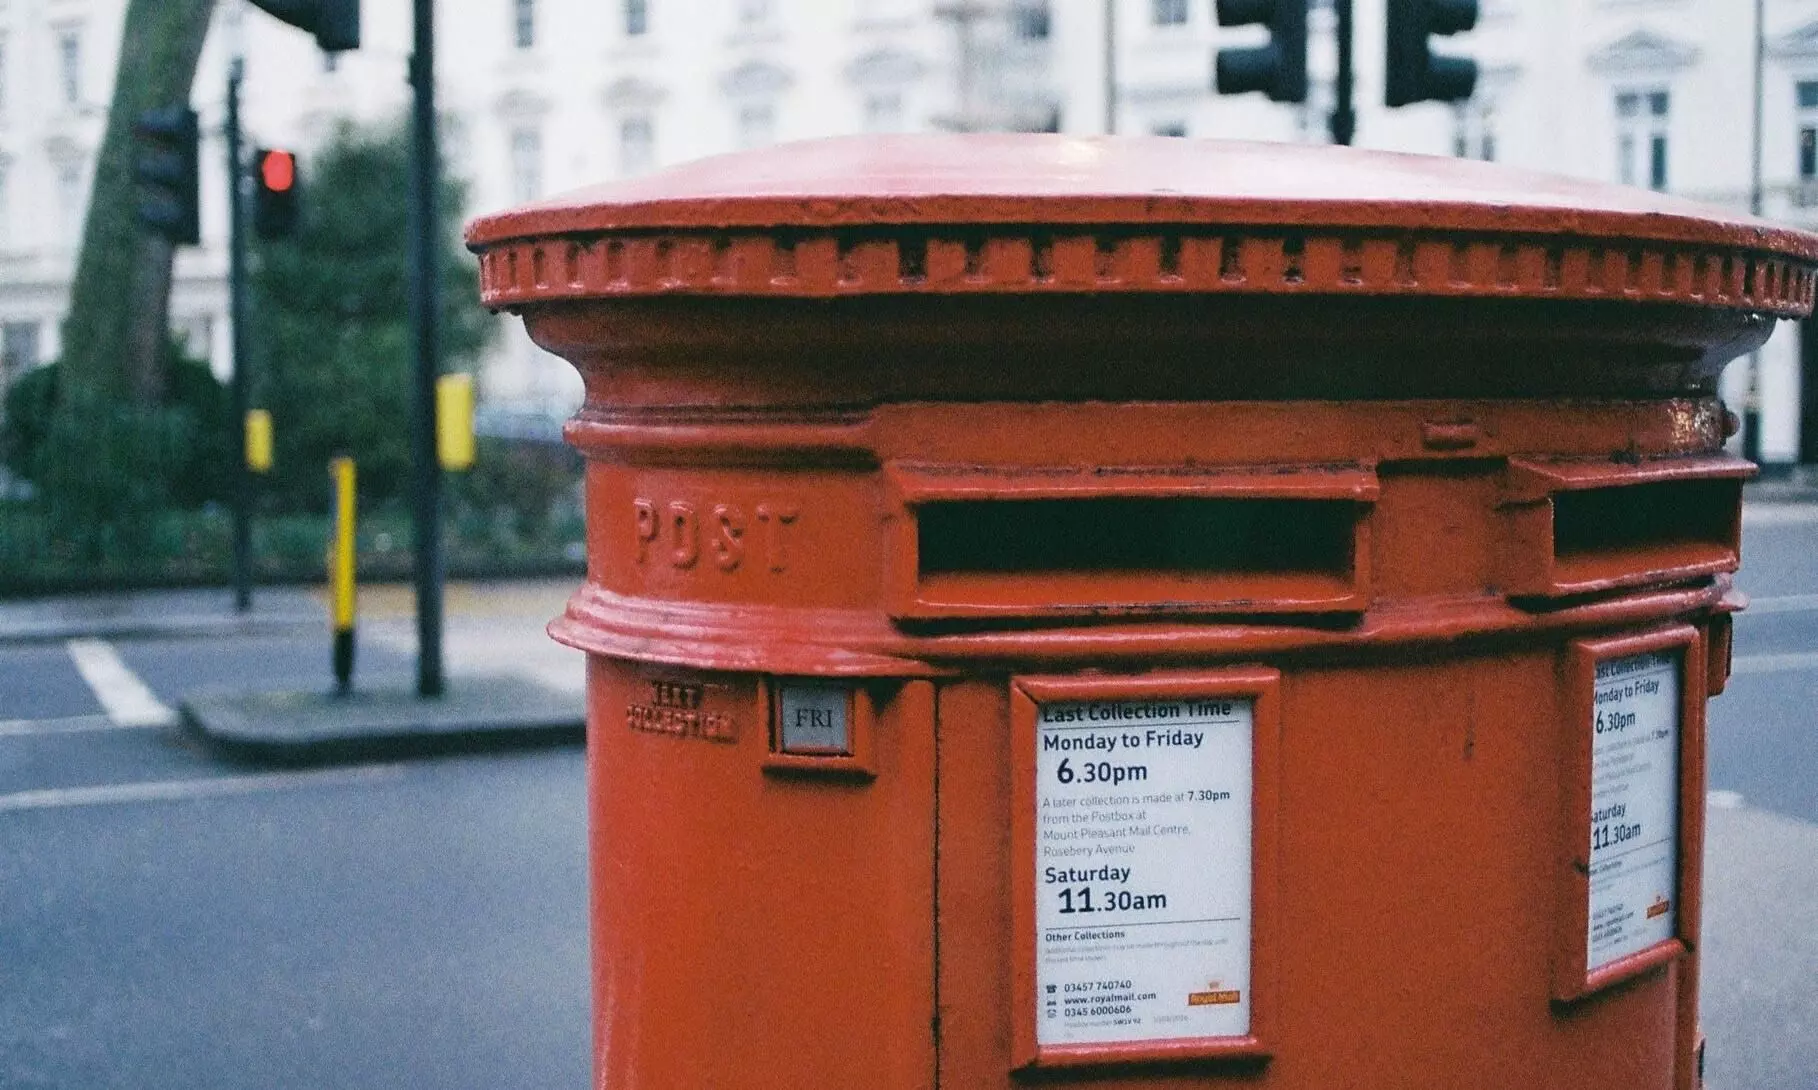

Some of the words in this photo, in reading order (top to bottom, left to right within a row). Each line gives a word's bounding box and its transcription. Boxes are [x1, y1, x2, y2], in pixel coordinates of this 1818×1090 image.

[633, 498, 801, 574] POST
[1625, 685, 1633, 698] to
[1635, 679, 1660, 696] Friday
[795, 708, 832, 728] FRI
[1043, 705, 1083, 722] Last
[1089, 702, 1180, 721] Collection
[1187, 700, 1231, 717] Time
[1596, 710, 1636, 734] 6.30pm
[1044, 733, 1117, 752] Monday
[1121, 733, 1140, 748] to
[1146, 730, 1204, 748] Friday
[1057, 758, 1148, 786] 6.30pm
[1080, 795, 1129, 807] collection
[1143, 793, 1172, 804] made
[1175, 792, 1184, 802] at
[1187, 790, 1230, 802] 7.30pm
[1043, 813, 1069, 825] from
[1072, 813, 1088, 824] the
[1092, 810, 1133, 823] Postbox
[1136, 810, 1147, 820] at
[1592, 803, 1626, 824] aturday
[1043, 829, 1078, 841] Mount
[1081, 827, 1126, 839] Pleasant
[1129, 825, 1151, 836] Mail
[1594, 823, 1641, 850] 11.30am
[1045, 865, 1131, 884] Saturday
[1058, 887, 1167, 914] 11.30am
[1045, 933, 1071, 942] Other
[1074, 930, 1125, 941] Collections
[1064, 983, 1094, 993] 03457
[1096, 980, 1132, 991] 740740
[1064, 992, 1157, 1004] www.royalmail.com
[1064, 1008, 1088, 1017] 0345
[1090, 1005, 1132, 1016] 6000606
